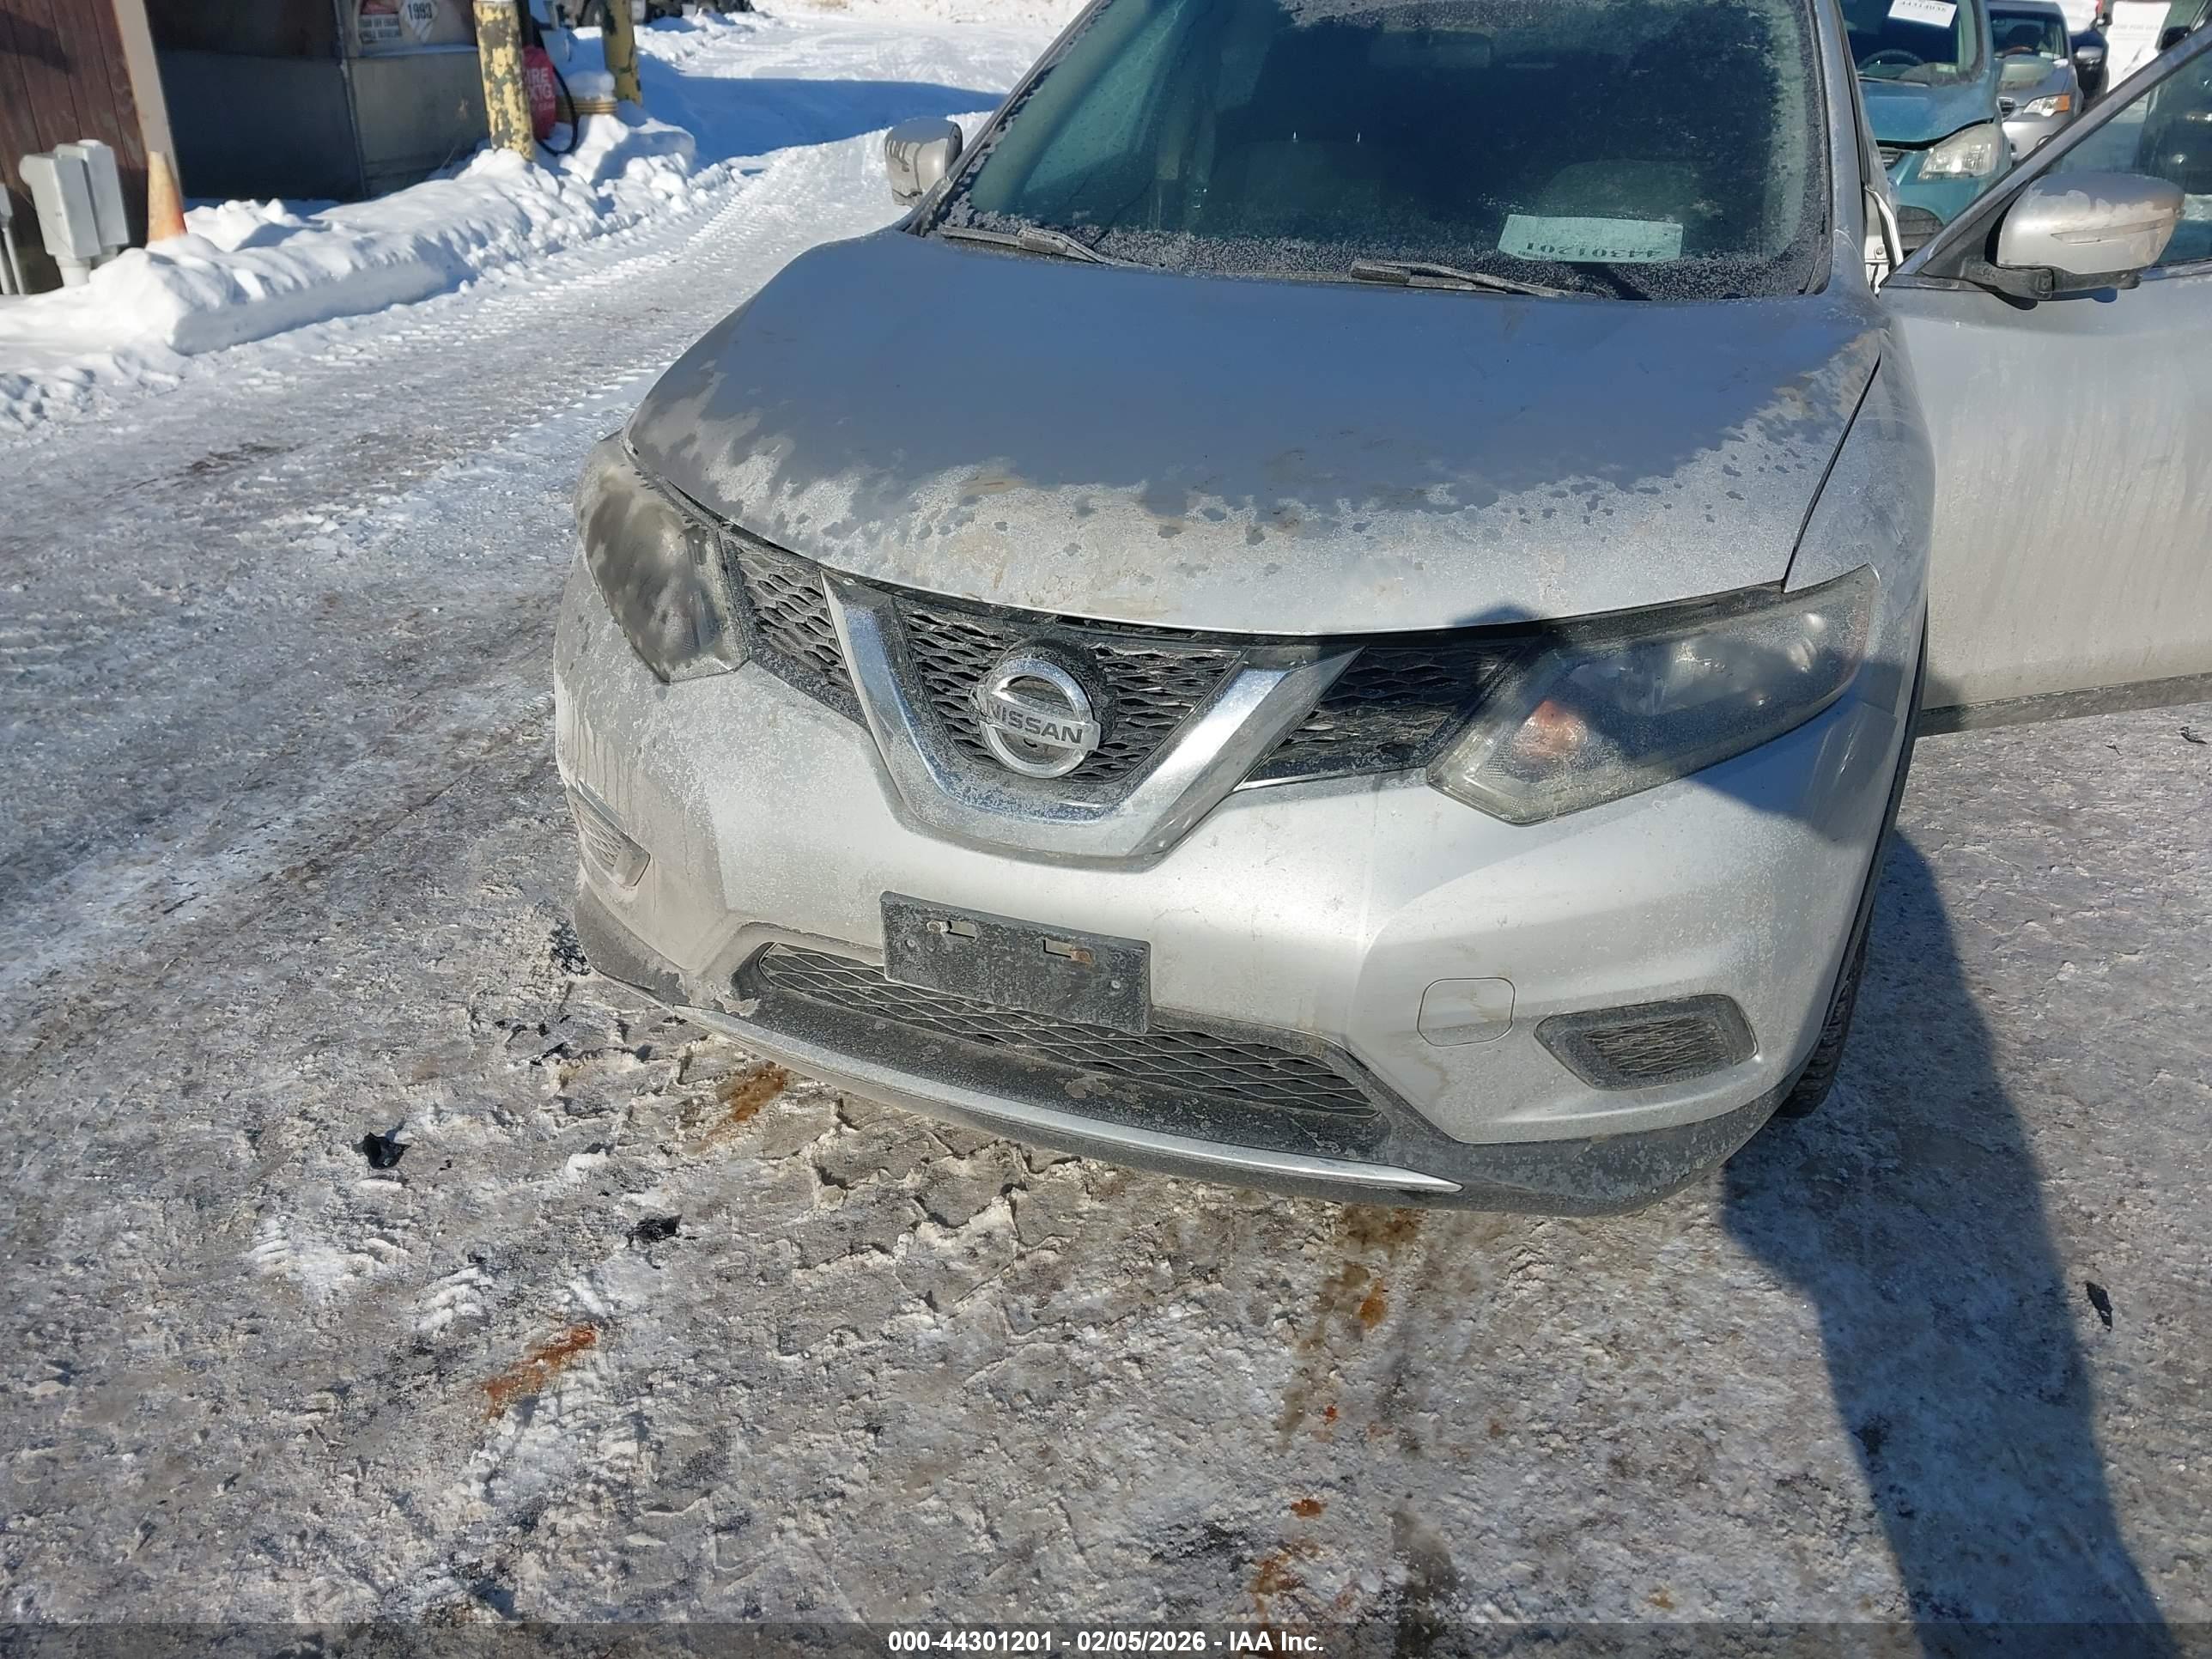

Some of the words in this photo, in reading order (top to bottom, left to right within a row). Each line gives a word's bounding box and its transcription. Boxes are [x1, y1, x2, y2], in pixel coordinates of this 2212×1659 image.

[408, 3, 433, 21] 1993
[526, 68, 550, 83] IRE
[1526, 241, 1662, 259] 44301201
[986, 699, 1084, 744] NISSAN
